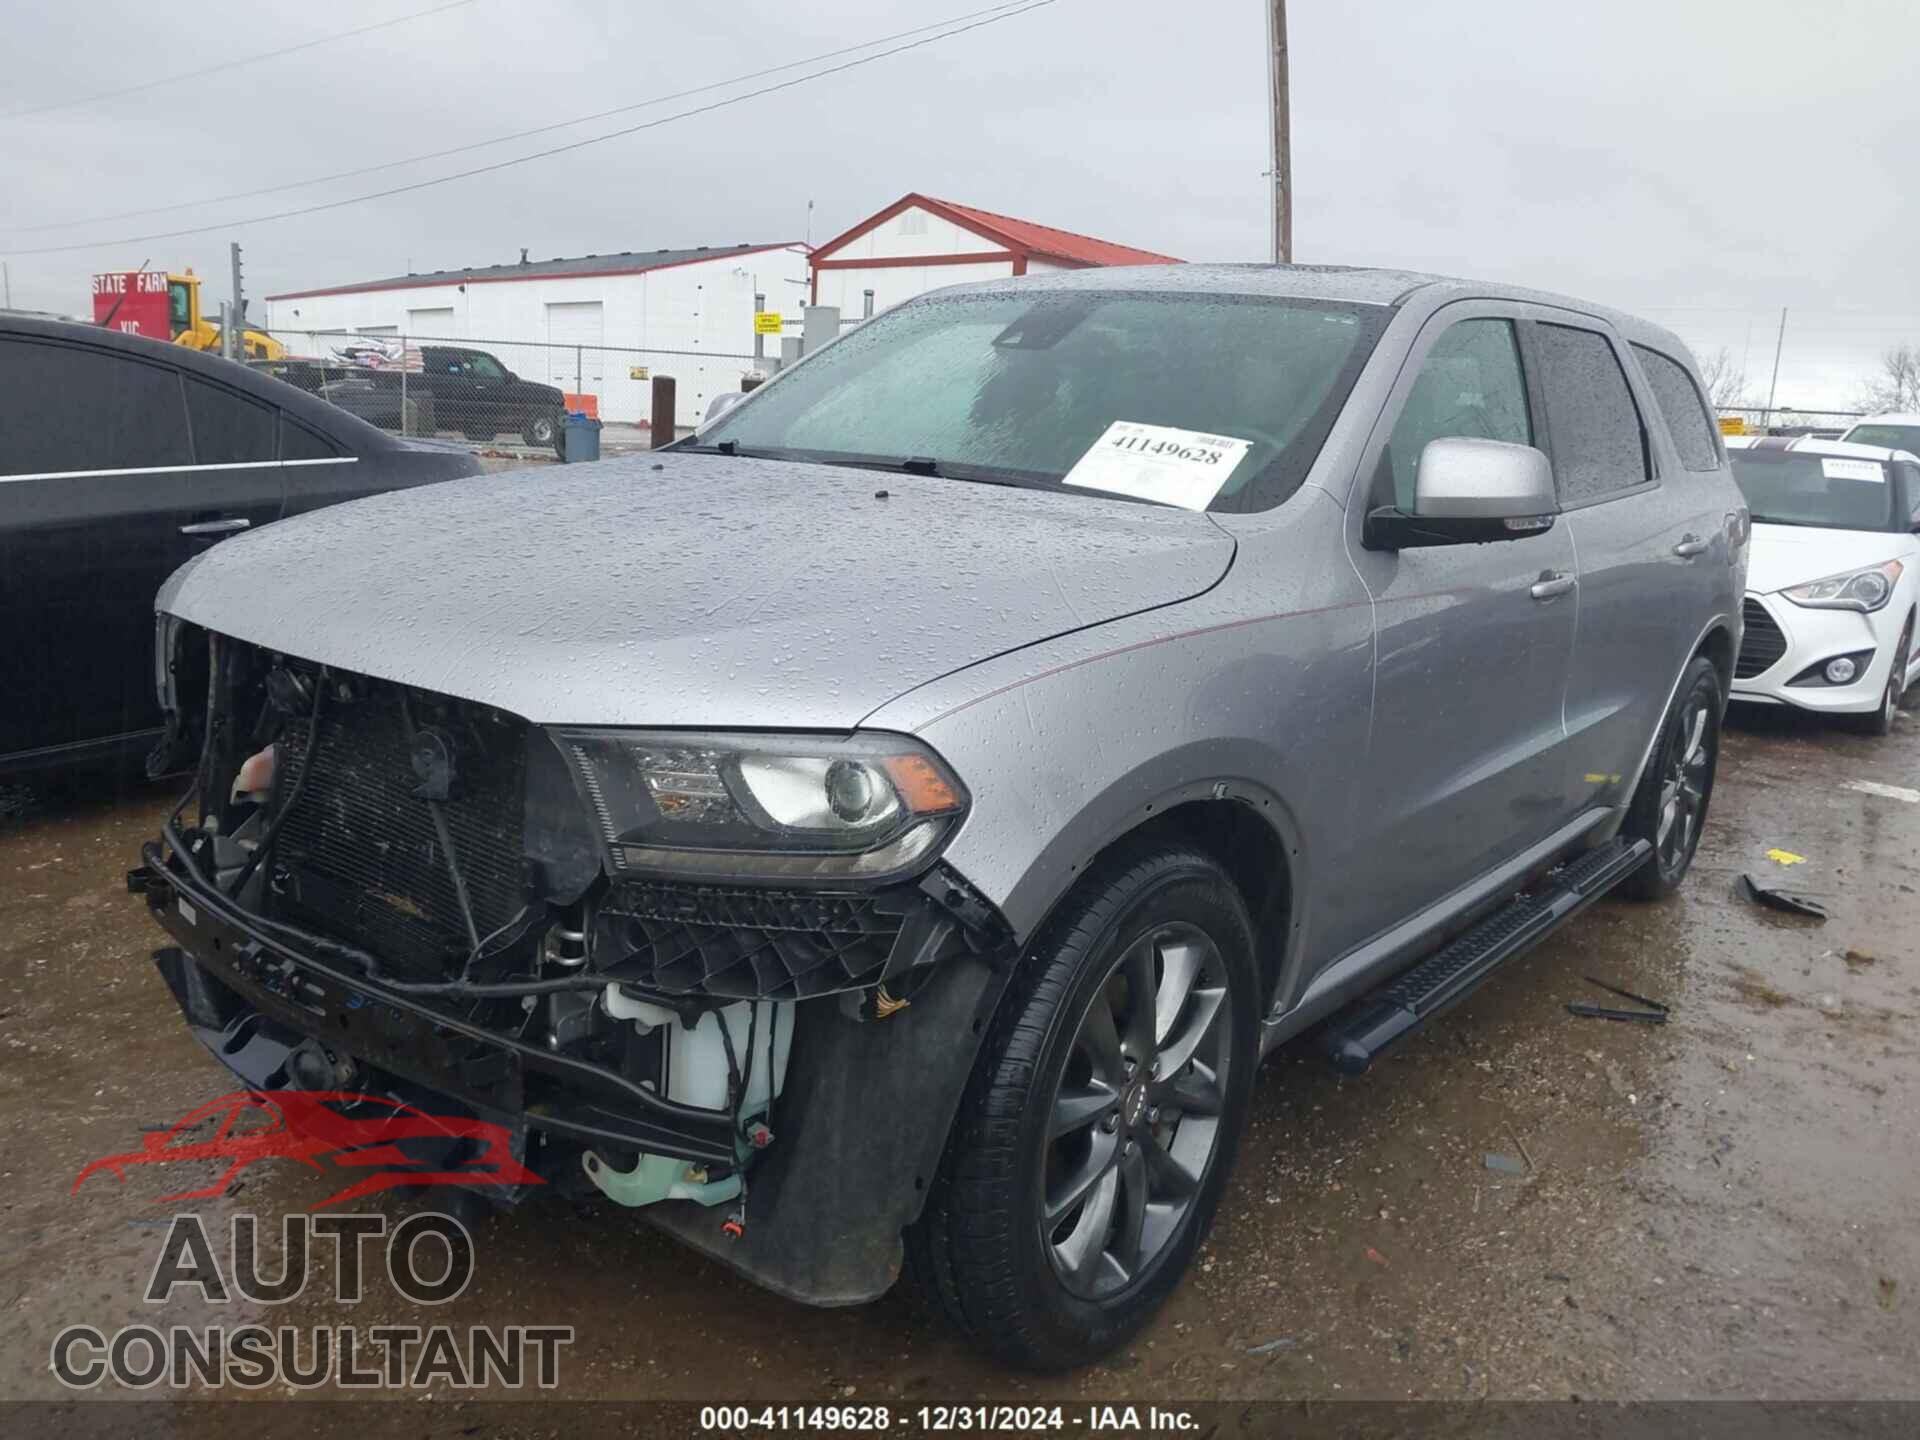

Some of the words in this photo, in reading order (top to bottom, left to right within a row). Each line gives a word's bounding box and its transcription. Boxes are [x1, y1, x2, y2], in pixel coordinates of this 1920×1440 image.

[93, 274, 127, 294] STATE
[136, 272, 169, 293] FARM
[1112, 435, 1222, 464] 41149628
